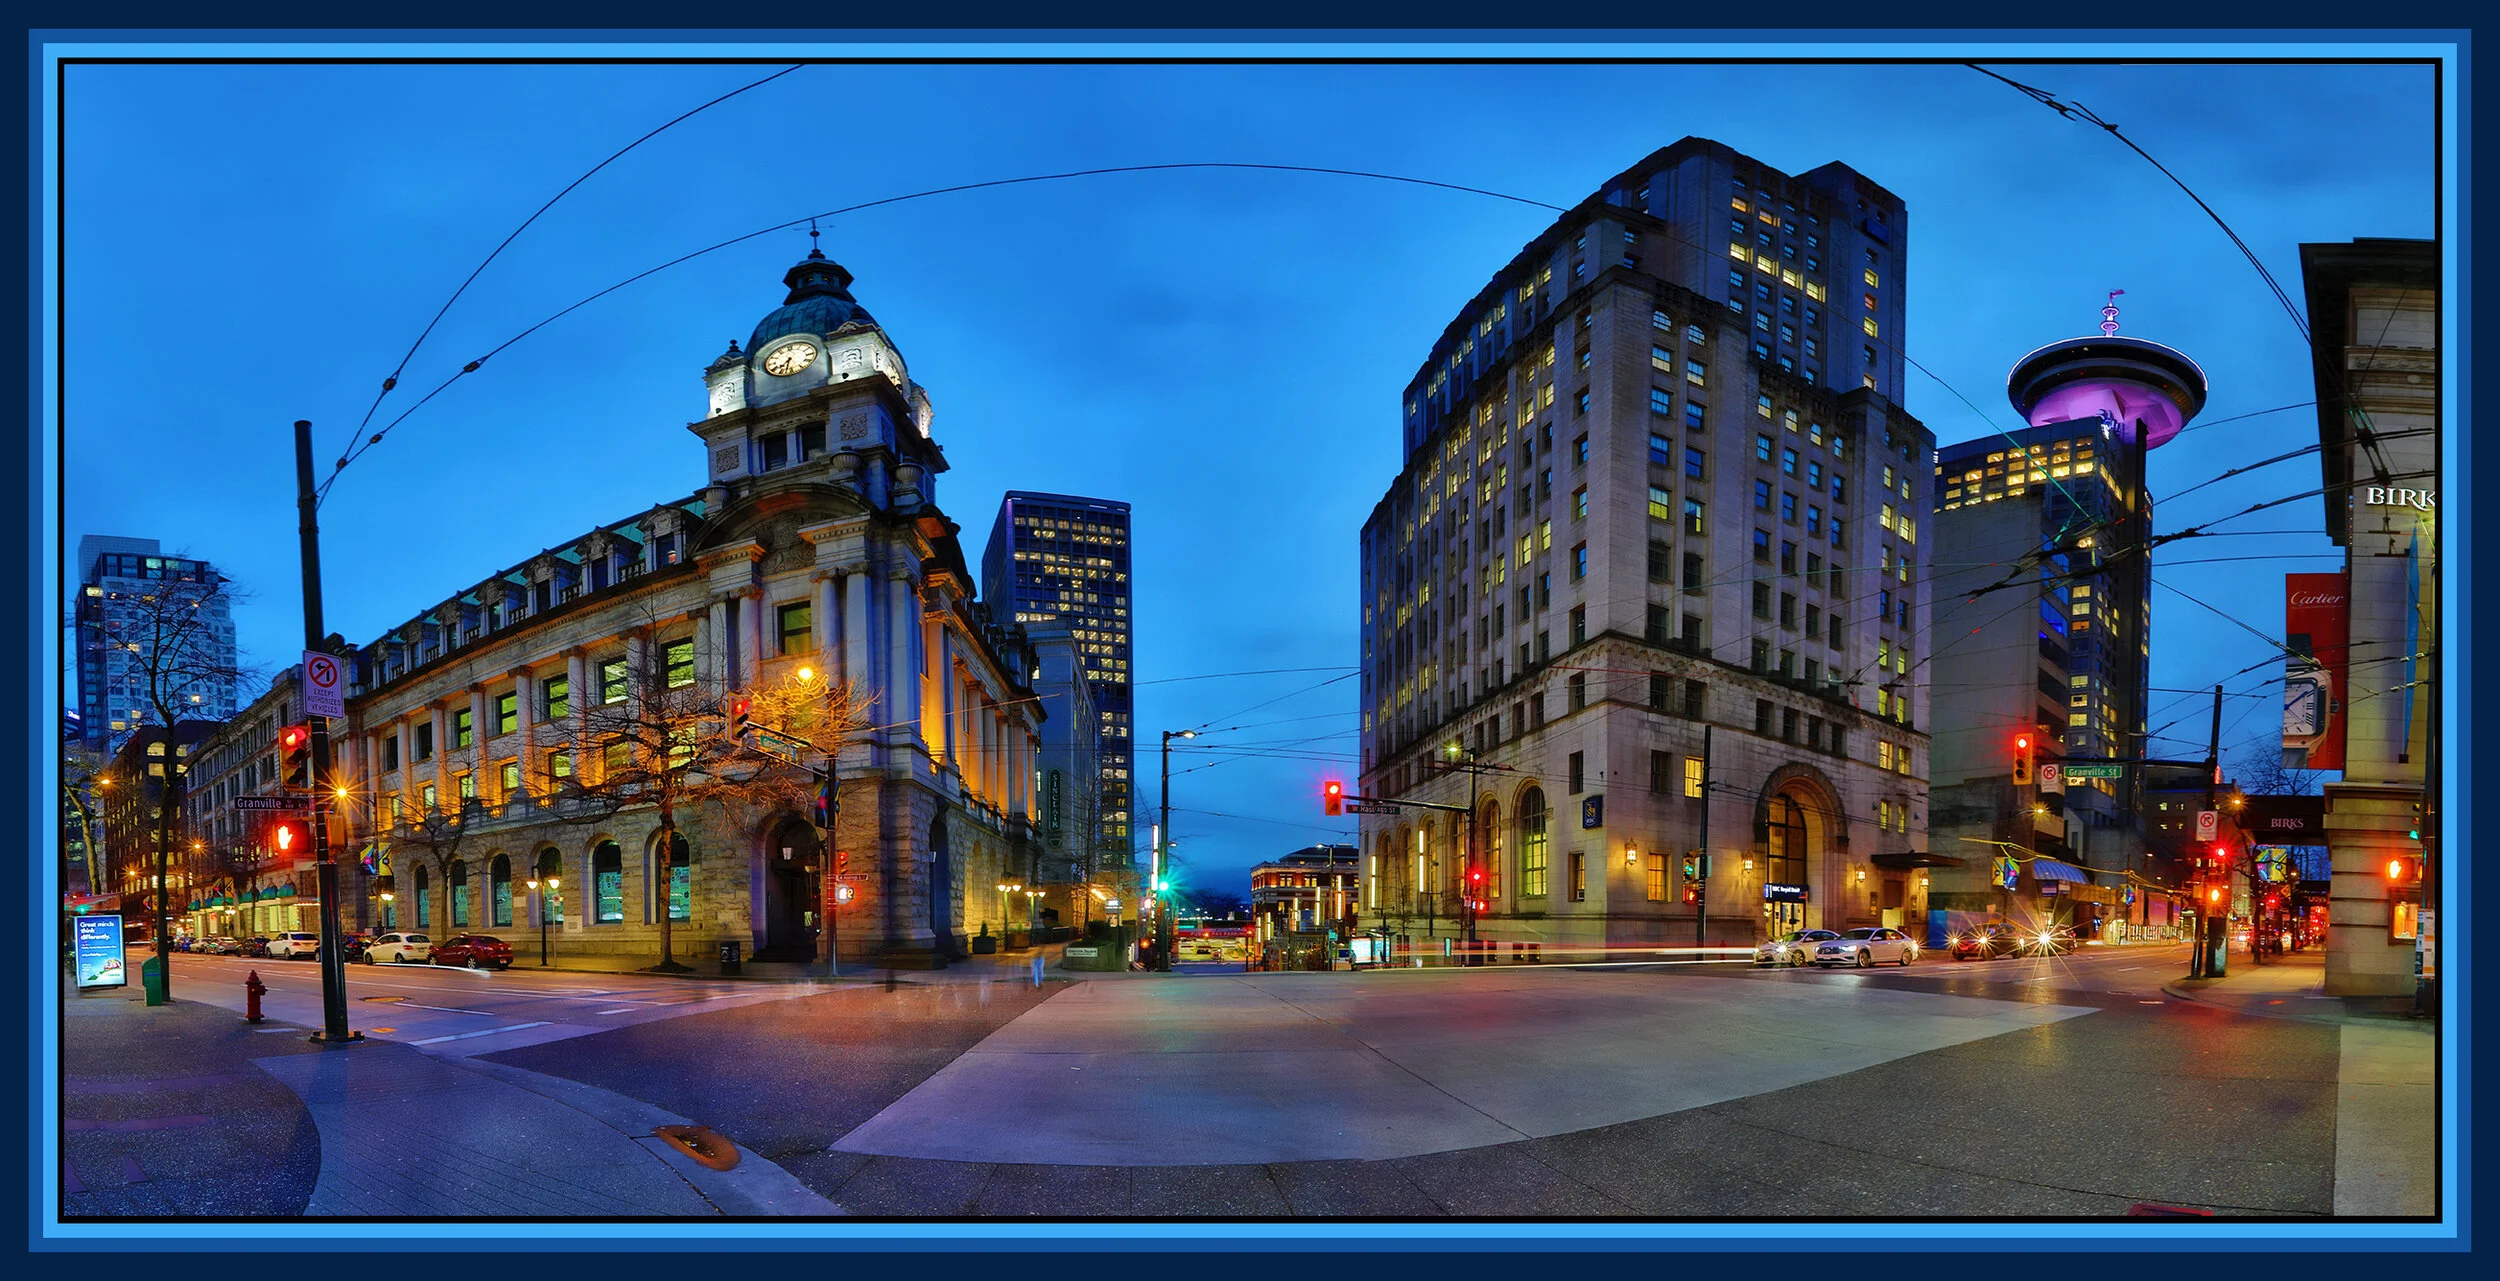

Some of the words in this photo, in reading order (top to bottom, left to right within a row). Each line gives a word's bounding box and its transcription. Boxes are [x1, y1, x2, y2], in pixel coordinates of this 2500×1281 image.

[2290, 591, 2344, 606] Cartier
[313, 688, 334, 697] EXCEPT
[307, 695, 341, 706] AUTHORIZED
[311, 703, 338, 714] VEHICLES
[2068, 768, 2106, 776] Granville
[237, 798, 282, 809] Granville
[2271, 818, 2304, 829] BIRKS
